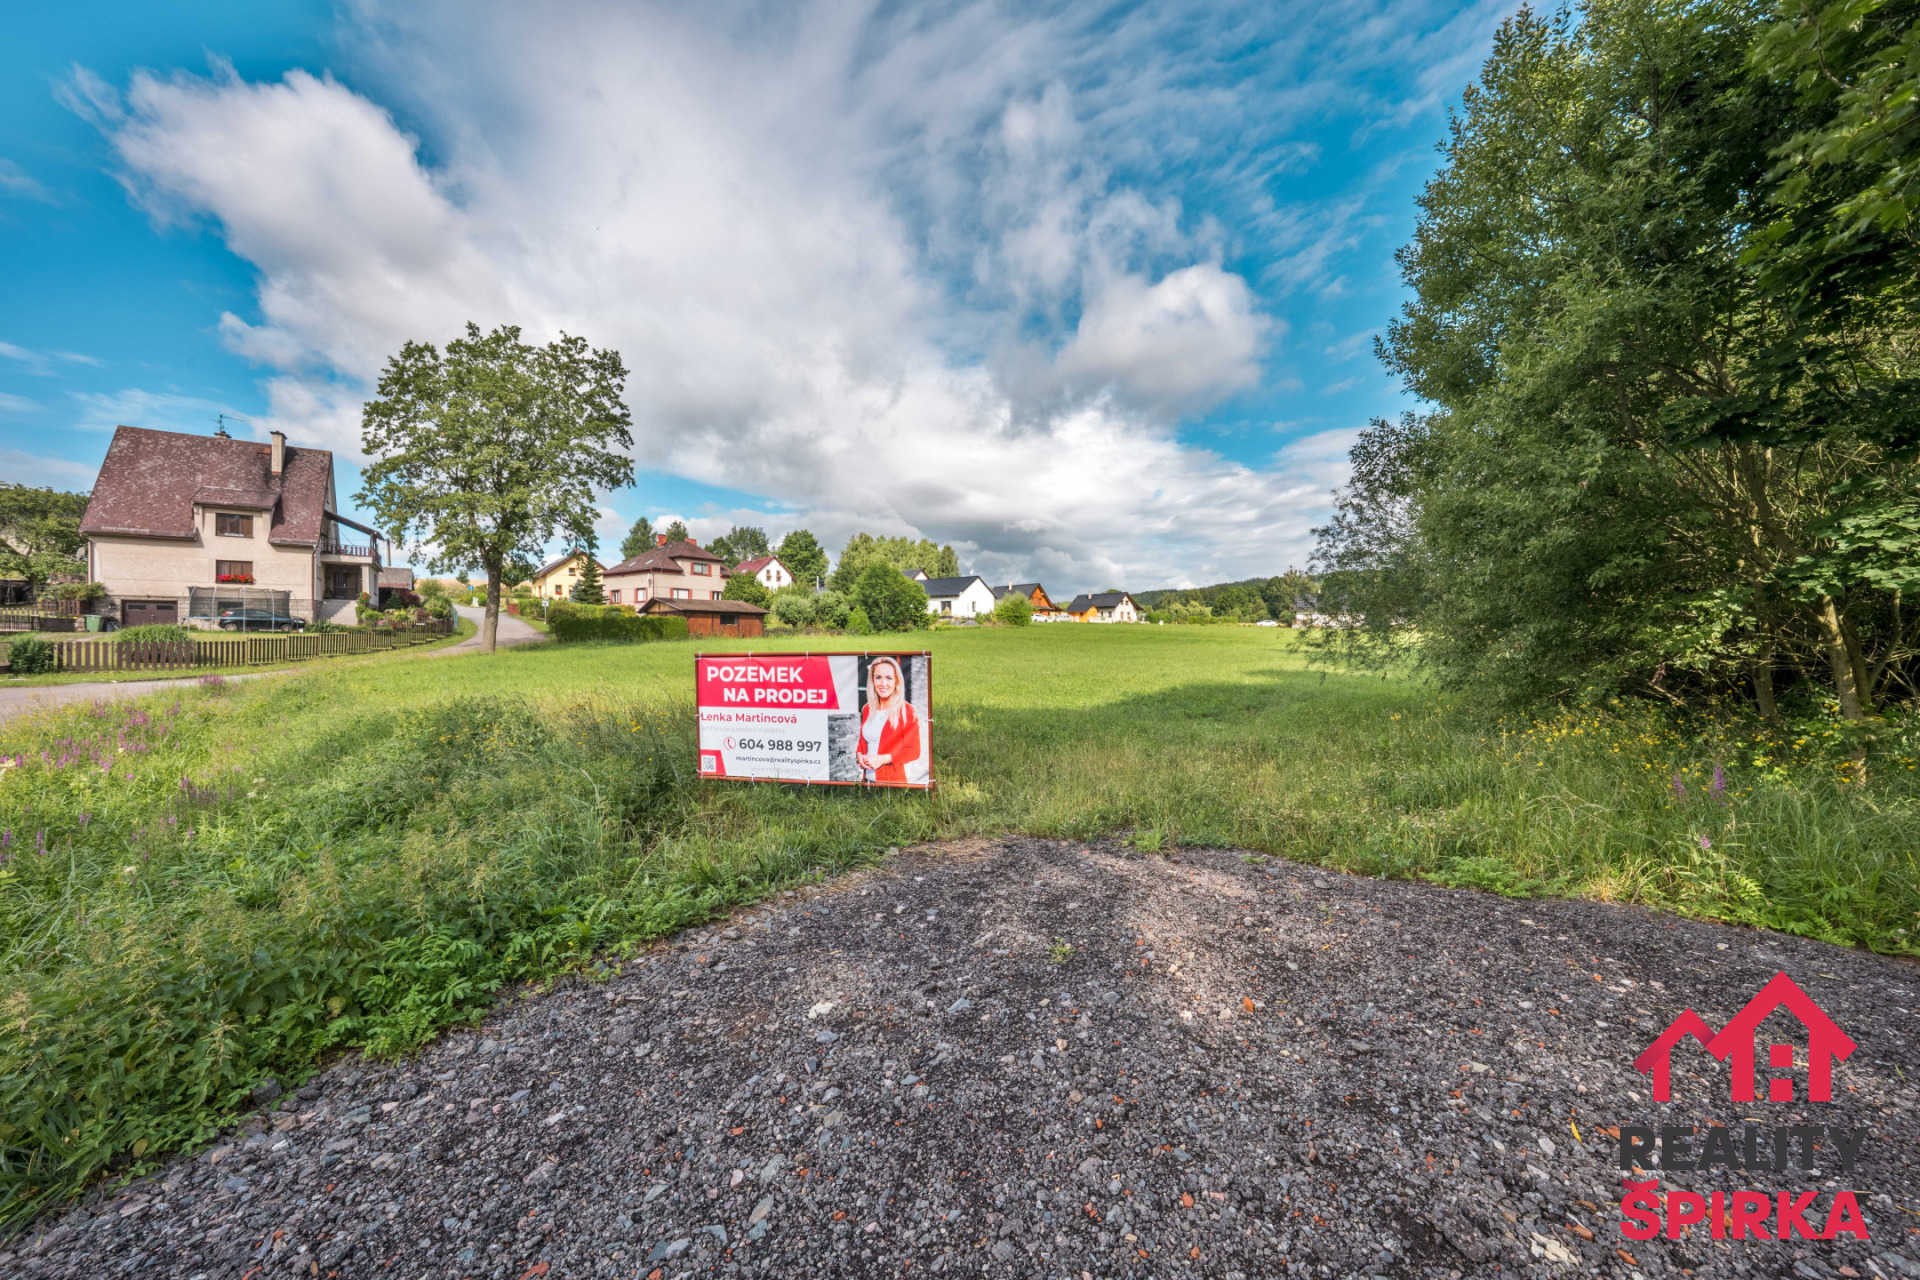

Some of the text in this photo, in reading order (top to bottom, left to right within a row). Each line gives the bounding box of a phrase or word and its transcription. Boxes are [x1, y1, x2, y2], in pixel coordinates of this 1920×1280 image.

[706, 666, 804, 683] POZEMEK
[723, 688, 828, 704] NA PRODEJ
[701, 712, 798, 724] Lenka Martincová
[739, 738, 822, 752] 604 988 997
